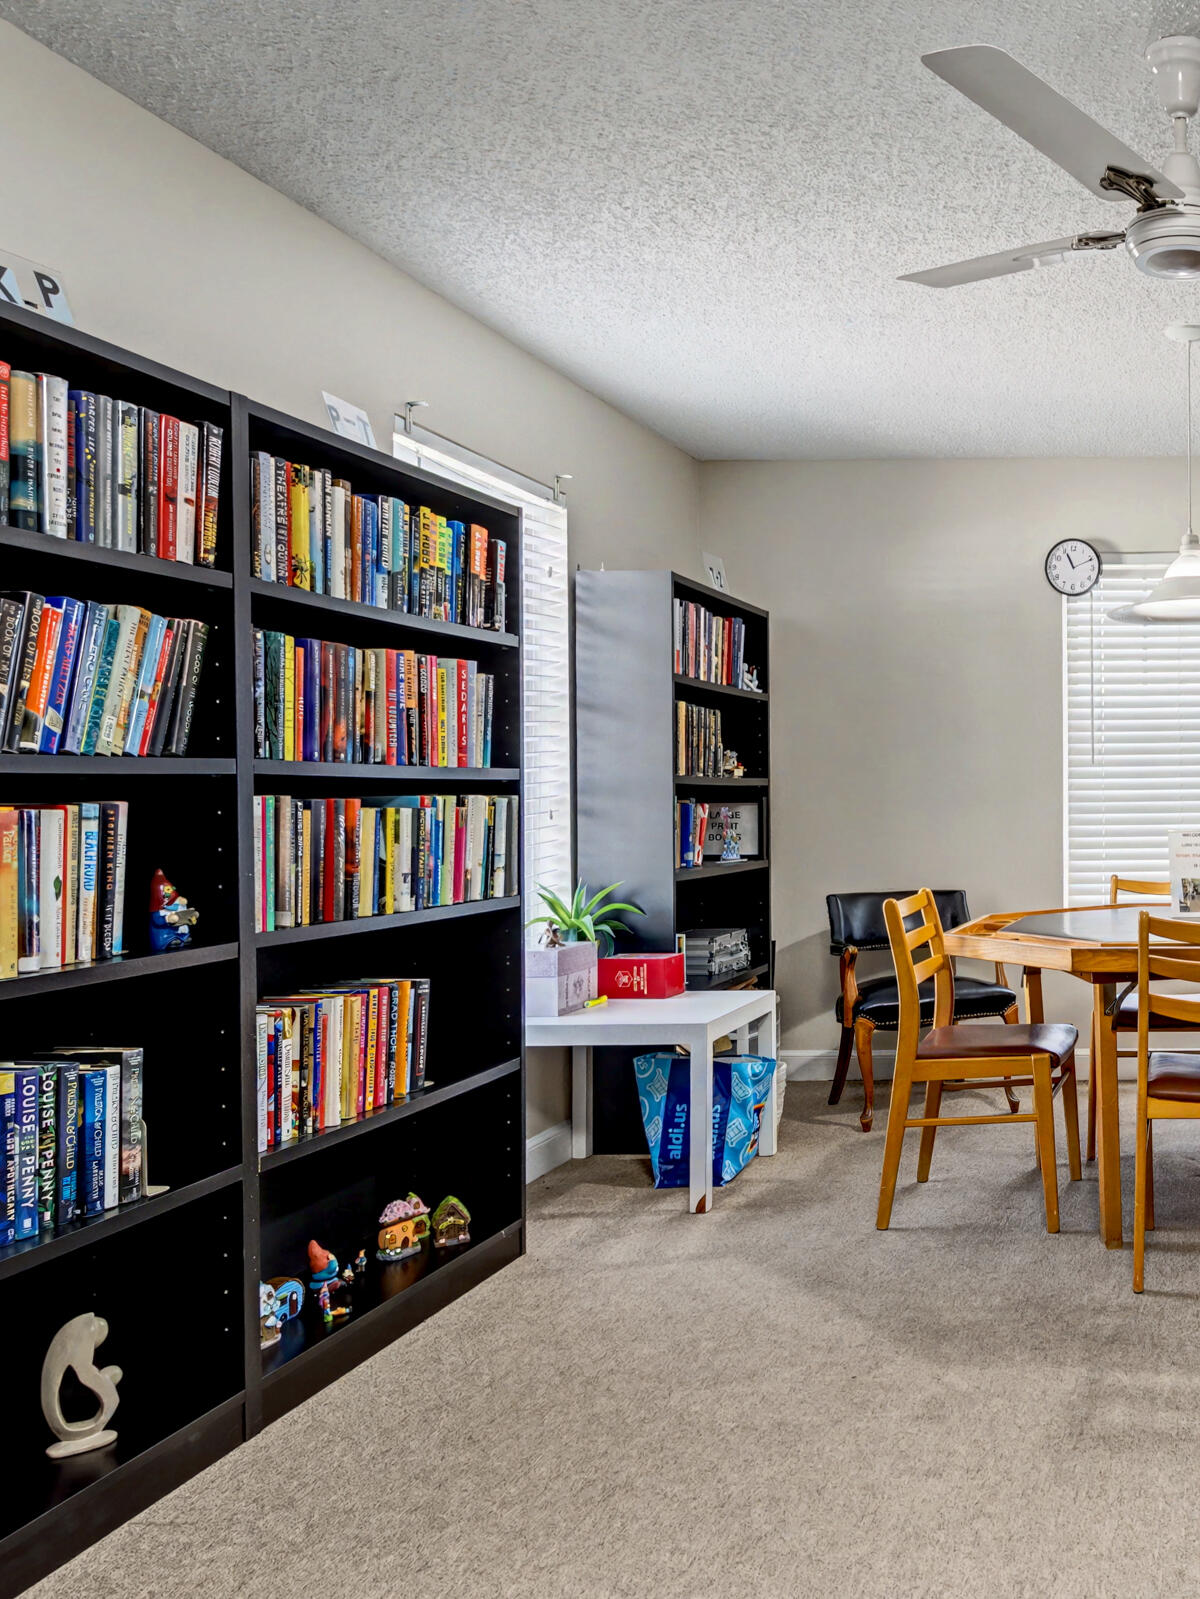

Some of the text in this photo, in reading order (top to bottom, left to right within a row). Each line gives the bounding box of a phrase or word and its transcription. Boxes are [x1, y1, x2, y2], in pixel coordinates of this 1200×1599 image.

[88, 396, 97, 432] HARPER
[207, 436, 221, 466] ROBERT
[4, 617, 16, 642] BOOK
[29, 609, 42, 638] BOOK
[709, 811, 741, 819] LAGE
[84, 831, 98, 891] BEACH ROAD
[106, 809, 115, 891] STEPHEN KING
[390, 990, 399, 1053] BRAD THOR
[66, 1081, 77, 1124] PRESTON
[20, 1075, 37, 1208] LOUISE PENNY
[41, 1071, 54, 1201] LOUISE PENNY
[65, 1135, 76, 1169] CHILD
[668, 1104, 687, 1159] aldi.us
[6, 1160, 14, 1221] APOTHECARY
